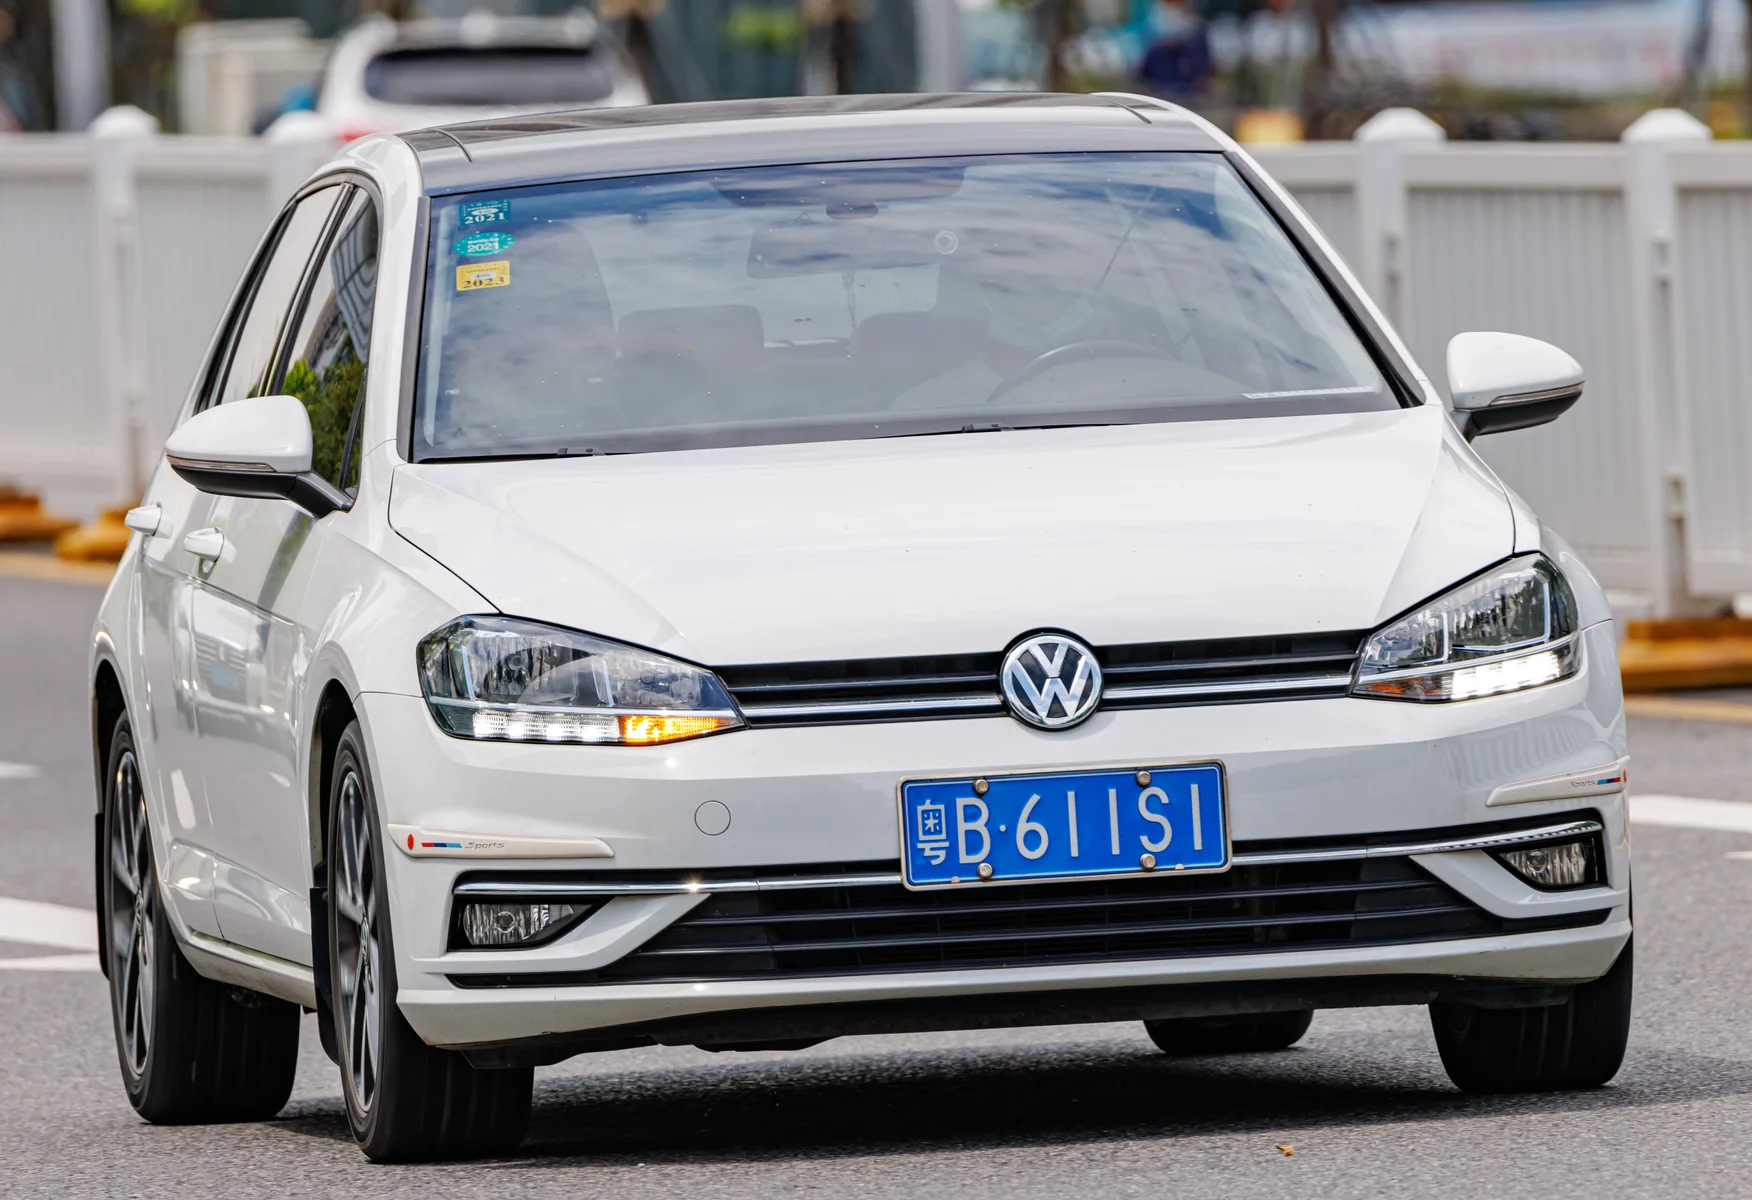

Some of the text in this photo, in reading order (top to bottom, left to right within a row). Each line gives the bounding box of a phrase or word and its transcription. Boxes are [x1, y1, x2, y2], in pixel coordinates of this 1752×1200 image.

[464, 212, 505, 224] 2021
[467, 241, 500, 253] 2021
[463, 276, 505, 288] 2023
[1006, 638, 1096, 723] VW
[464, 842, 505, 850] Sports
